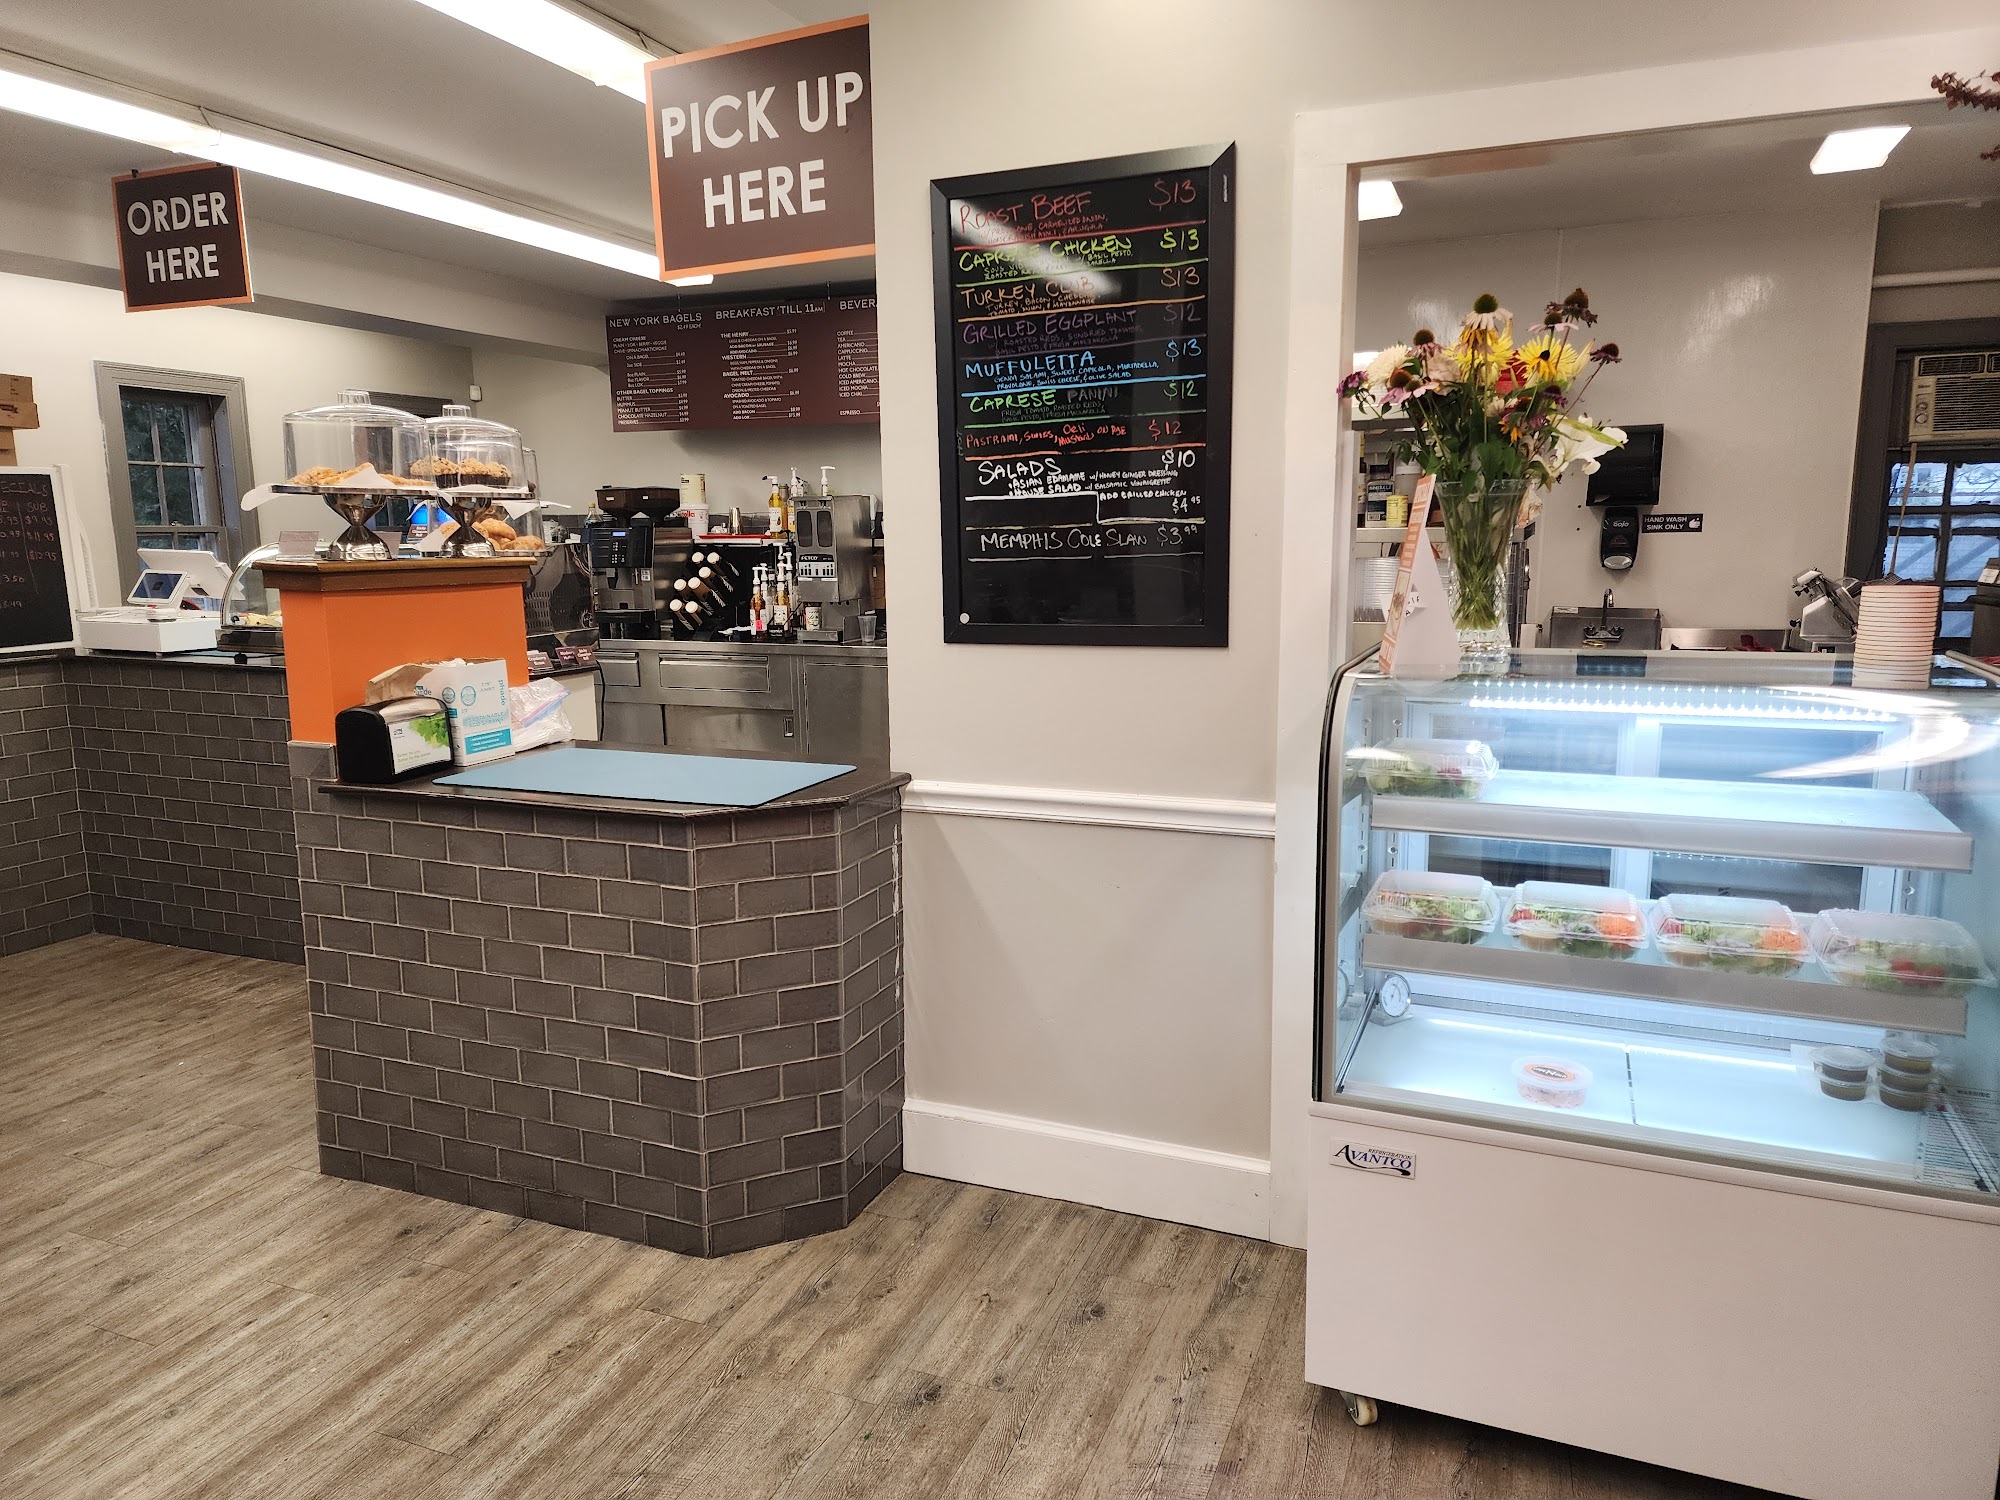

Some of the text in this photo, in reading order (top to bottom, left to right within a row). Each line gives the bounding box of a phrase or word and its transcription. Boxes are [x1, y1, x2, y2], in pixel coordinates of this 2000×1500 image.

[661, 71, 863, 158] PICK UP
[703, 158, 826, 228] HERE
[959, 178, 1197, 235] ROAST BEEF $13
[127, 191, 229, 235] ORDER
[1049, 234, 1132, 257] CHICKEN
[1159, 228, 1200, 253] $13
[145, 243, 220, 284] HERE
[961, 266, 1200, 309] TURKEY CLUB $13
[609, 312, 702, 328] NEW YORK BAGELS
[715, 307, 775, 320] BREAKFAST
[839, 298, 877, 310] BEVER
[963, 302, 1202, 344] GRILLED EGGPLANT $12
[837, 347, 868, 355] CAPPUCCINO
[965, 338, 1202, 379] MUFFULETTA $13
[969, 379, 1200, 413] CAPRESE PANINI $12
[965, 433, 1023, 449] PASTRAMI,
[1148, 418, 1182, 442] $12
[977, 447, 1196, 485] SALADS $10
[1012, 478, 1043, 490] ASIAN
[1122, 470, 1147, 479] GINGER
[1047, 482, 1082, 496] SALAD
[1099, 491, 1119, 502] ADD
[981, 530, 1064, 551] MEMPHIS
[1067, 527, 1102, 548] COLE
[1105, 528, 1147, 547] SLAW
